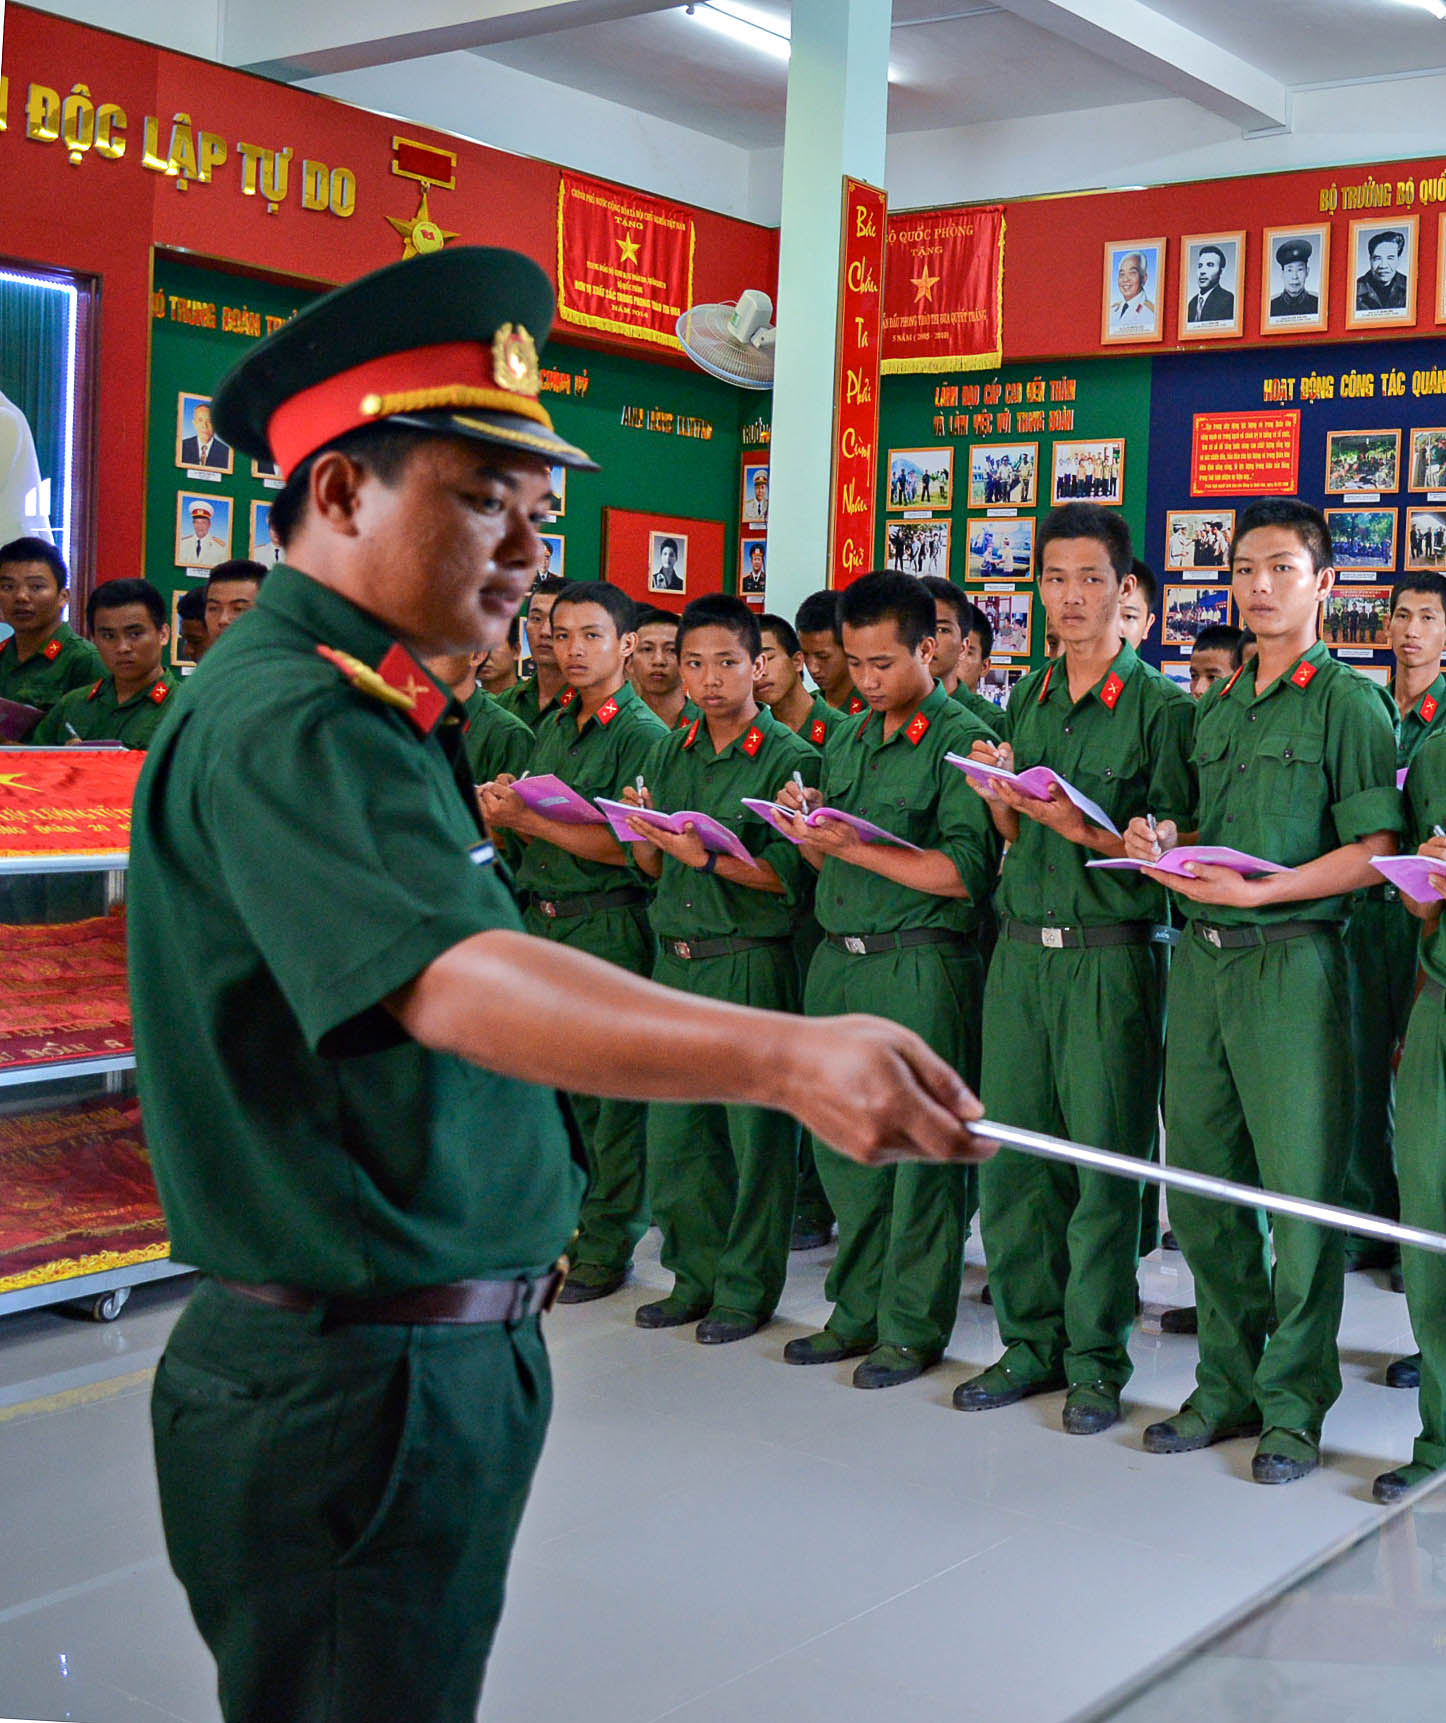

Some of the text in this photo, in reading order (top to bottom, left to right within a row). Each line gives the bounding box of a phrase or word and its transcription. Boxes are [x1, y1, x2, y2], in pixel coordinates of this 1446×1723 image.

[25, 83, 127, 165] ĐỘC
[142, 112, 227, 191] LẬP
[237, 141, 293, 215] TỰ
[302, 159, 356, 218] DO
[1319, 183, 1337, 215] BỘ
[1341, 176, 1392, 211] TRƯỞNG
[1396, 177, 1415, 209] BỘ
[856, 205, 876, 238] Bác
[900, 223, 931, 243] QUỐC
[934, 223, 974, 240] PHÒNG
[911, 246, 943, 259] TẶNG
[848, 256, 878, 294] Cháu
[168, 295, 216, 329] TRUNG
[222, 304, 261, 337] ĐOÀN
[855, 316, 868, 349] Ta
[846, 368, 871, 406] Phải
[935, 376, 1076, 409] LÃNH ĐẠO CẤP CAO ĐẾN THĂM
[1263, 378, 1295, 406] HOẠT
[1300, 371, 1334, 404] ĐỘNG
[1340, 369, 1374, 398] CÔNG
[1380, 368, 1406, 397] TÁC
[933, 405, 1074, 438] VÀ LÀM VIỆC VỚI TRUNG ĐOÀN
[842, 428, 871, 487] Cùng
[842, 478, 868, 515] Nhau
